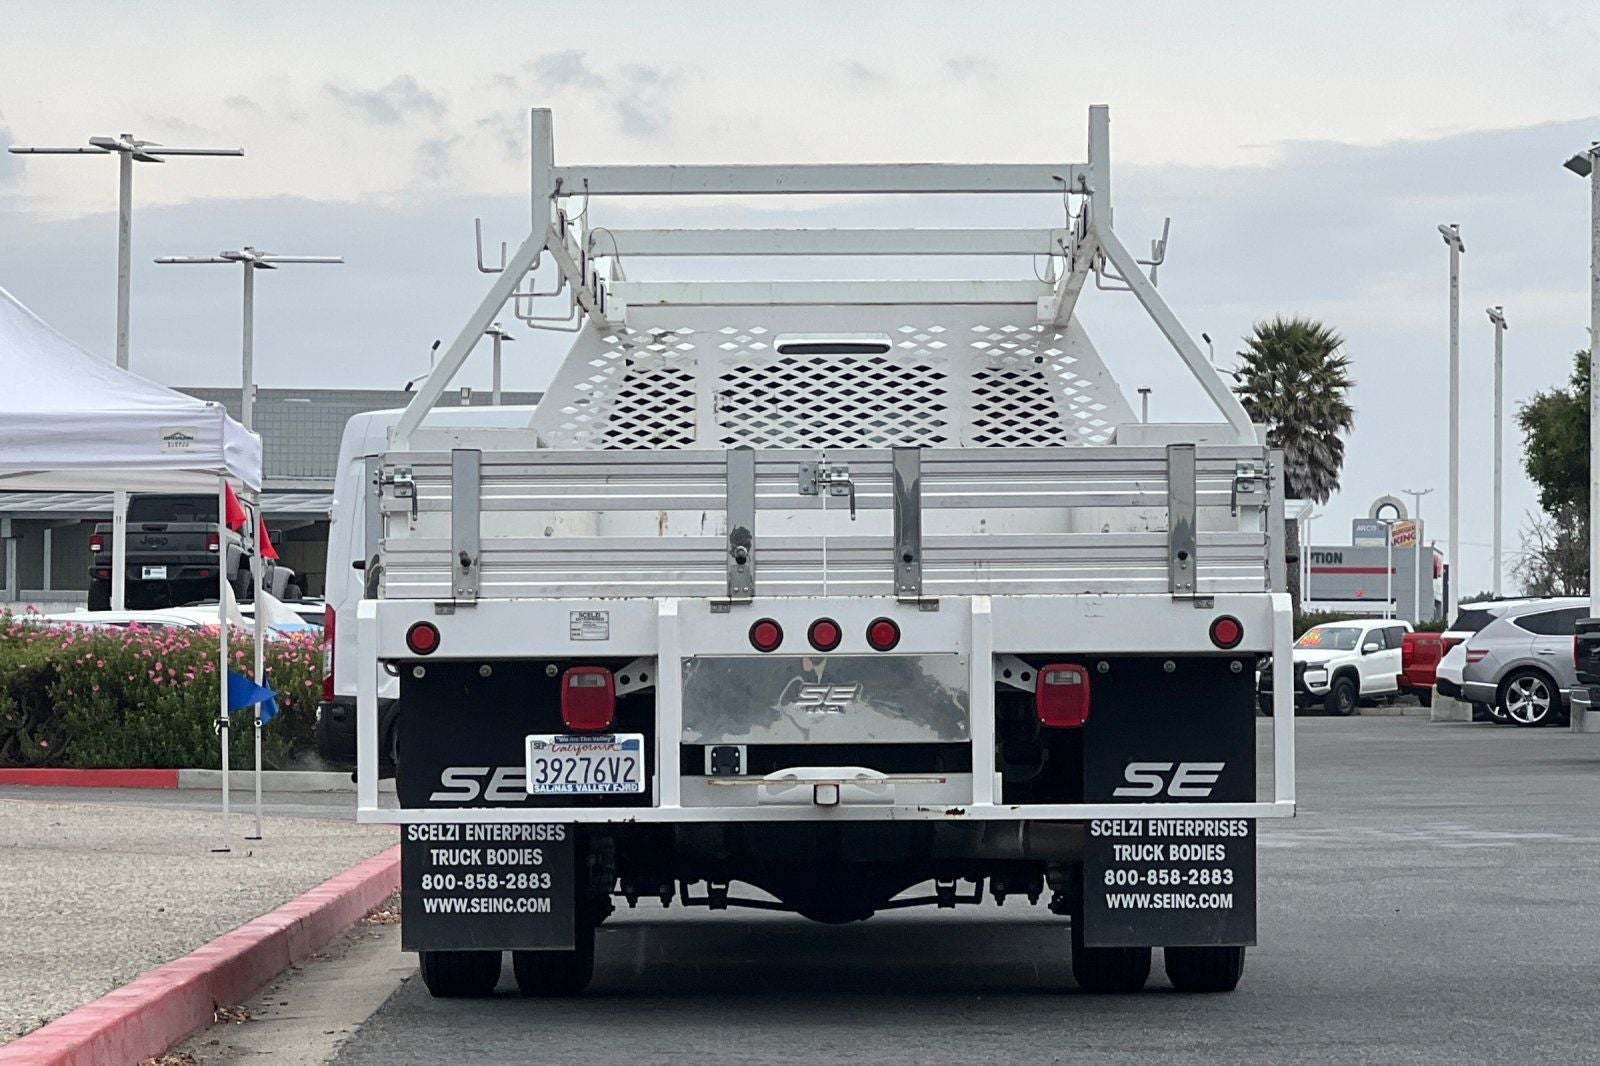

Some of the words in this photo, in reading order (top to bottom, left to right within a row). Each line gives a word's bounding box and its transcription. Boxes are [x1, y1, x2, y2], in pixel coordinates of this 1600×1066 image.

[140, 535, 168, 546] Jeep
[1393, 532, 1417, 546] KING
[795, 685, 858, 705] SE
[533, 741, 547, 750] SEP
[552, 743, 617, 756] California
[535, 757, 636, 784] 39276V2
[429, 767, 528, 801] SE
[1112, 762, 1226, 797] SE
[534, 784, 574, 793] SALINAS
[576, 784, 610, 792] VALLEY
[408, 824, 460, 841] SCELZI
[466, 824, 566, 841] ENTERPRISES
[1090, 819, 1143, 837] SCELZI
[1148, 820, 1249, 837] ENTERPRISES
[430, 849, 482, 866] TRUCK
[486, 848, 543, 865] BODIES
[1113, 844, 1165, 861] TRUCK
[1169, 844, 1226, 861] BODIES
[421, 873, 552, 890] 800-858-2883
[1104, 868, 1234, 886] 800-858-2883
[423, 897, 551, 913] WWW.SEINC.COM
[1105, 893, 1233, 909] WWW.SEINC.COM
